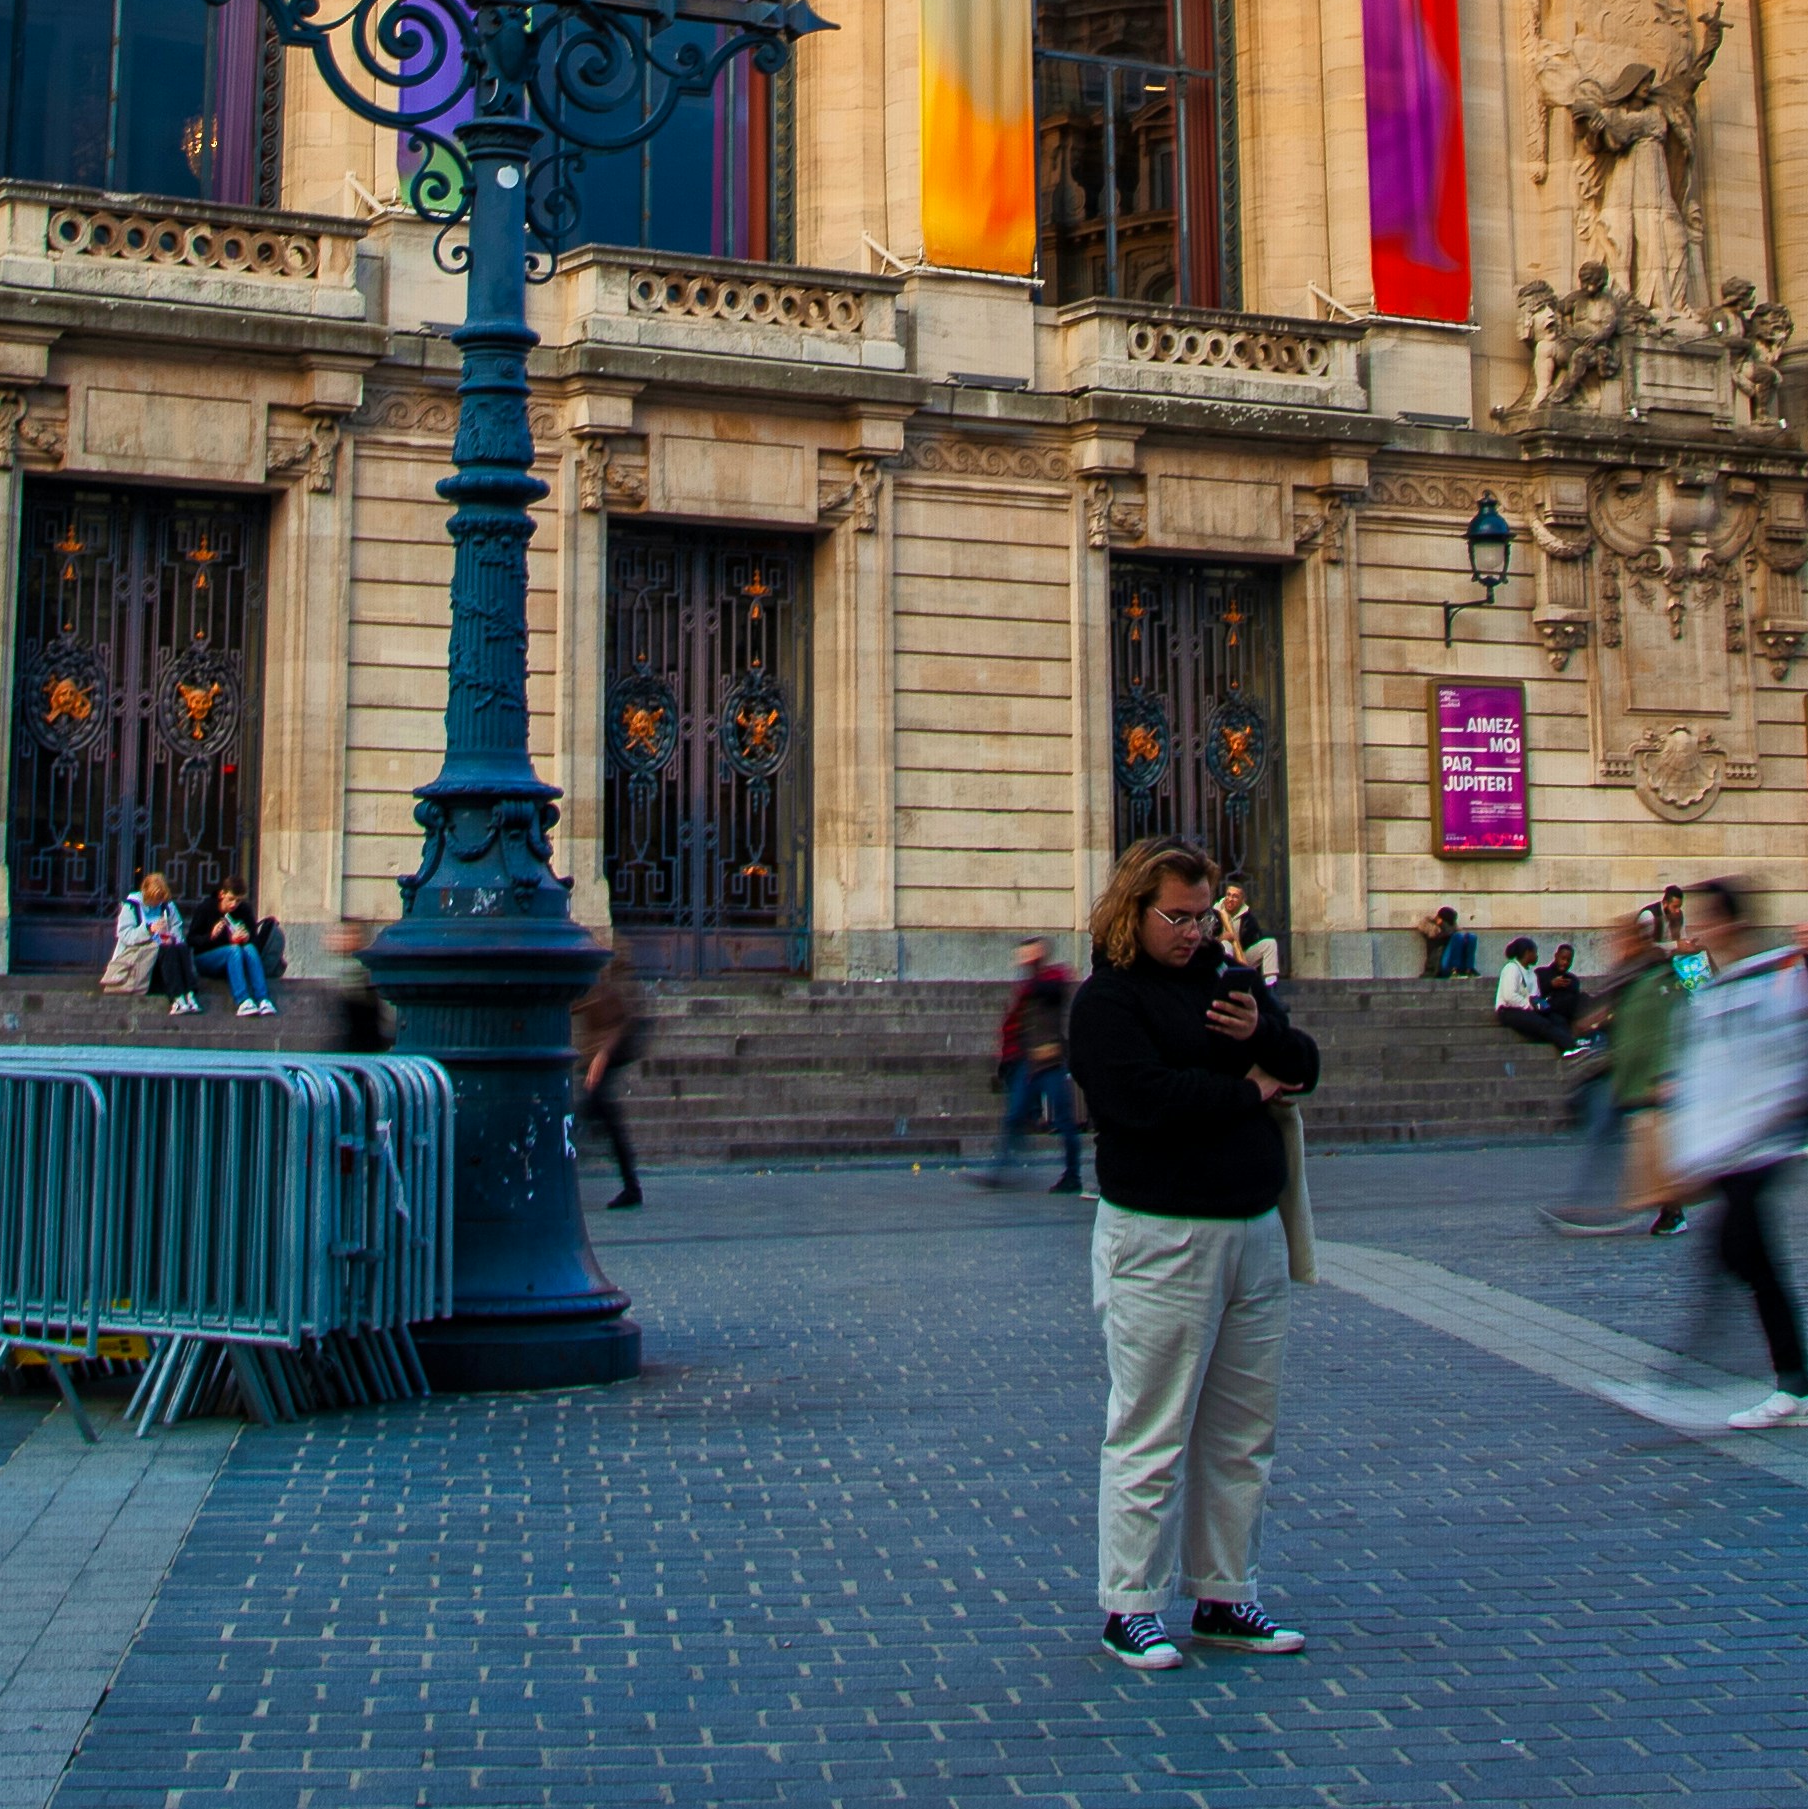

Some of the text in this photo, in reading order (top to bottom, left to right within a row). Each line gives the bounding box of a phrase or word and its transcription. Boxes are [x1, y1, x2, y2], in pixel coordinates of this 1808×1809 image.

[1466, 717, 1520, 734] AIMEZ-
[1489, 737, 1521, 754] MOI
[1442, 756, 1473, 772] PAR
